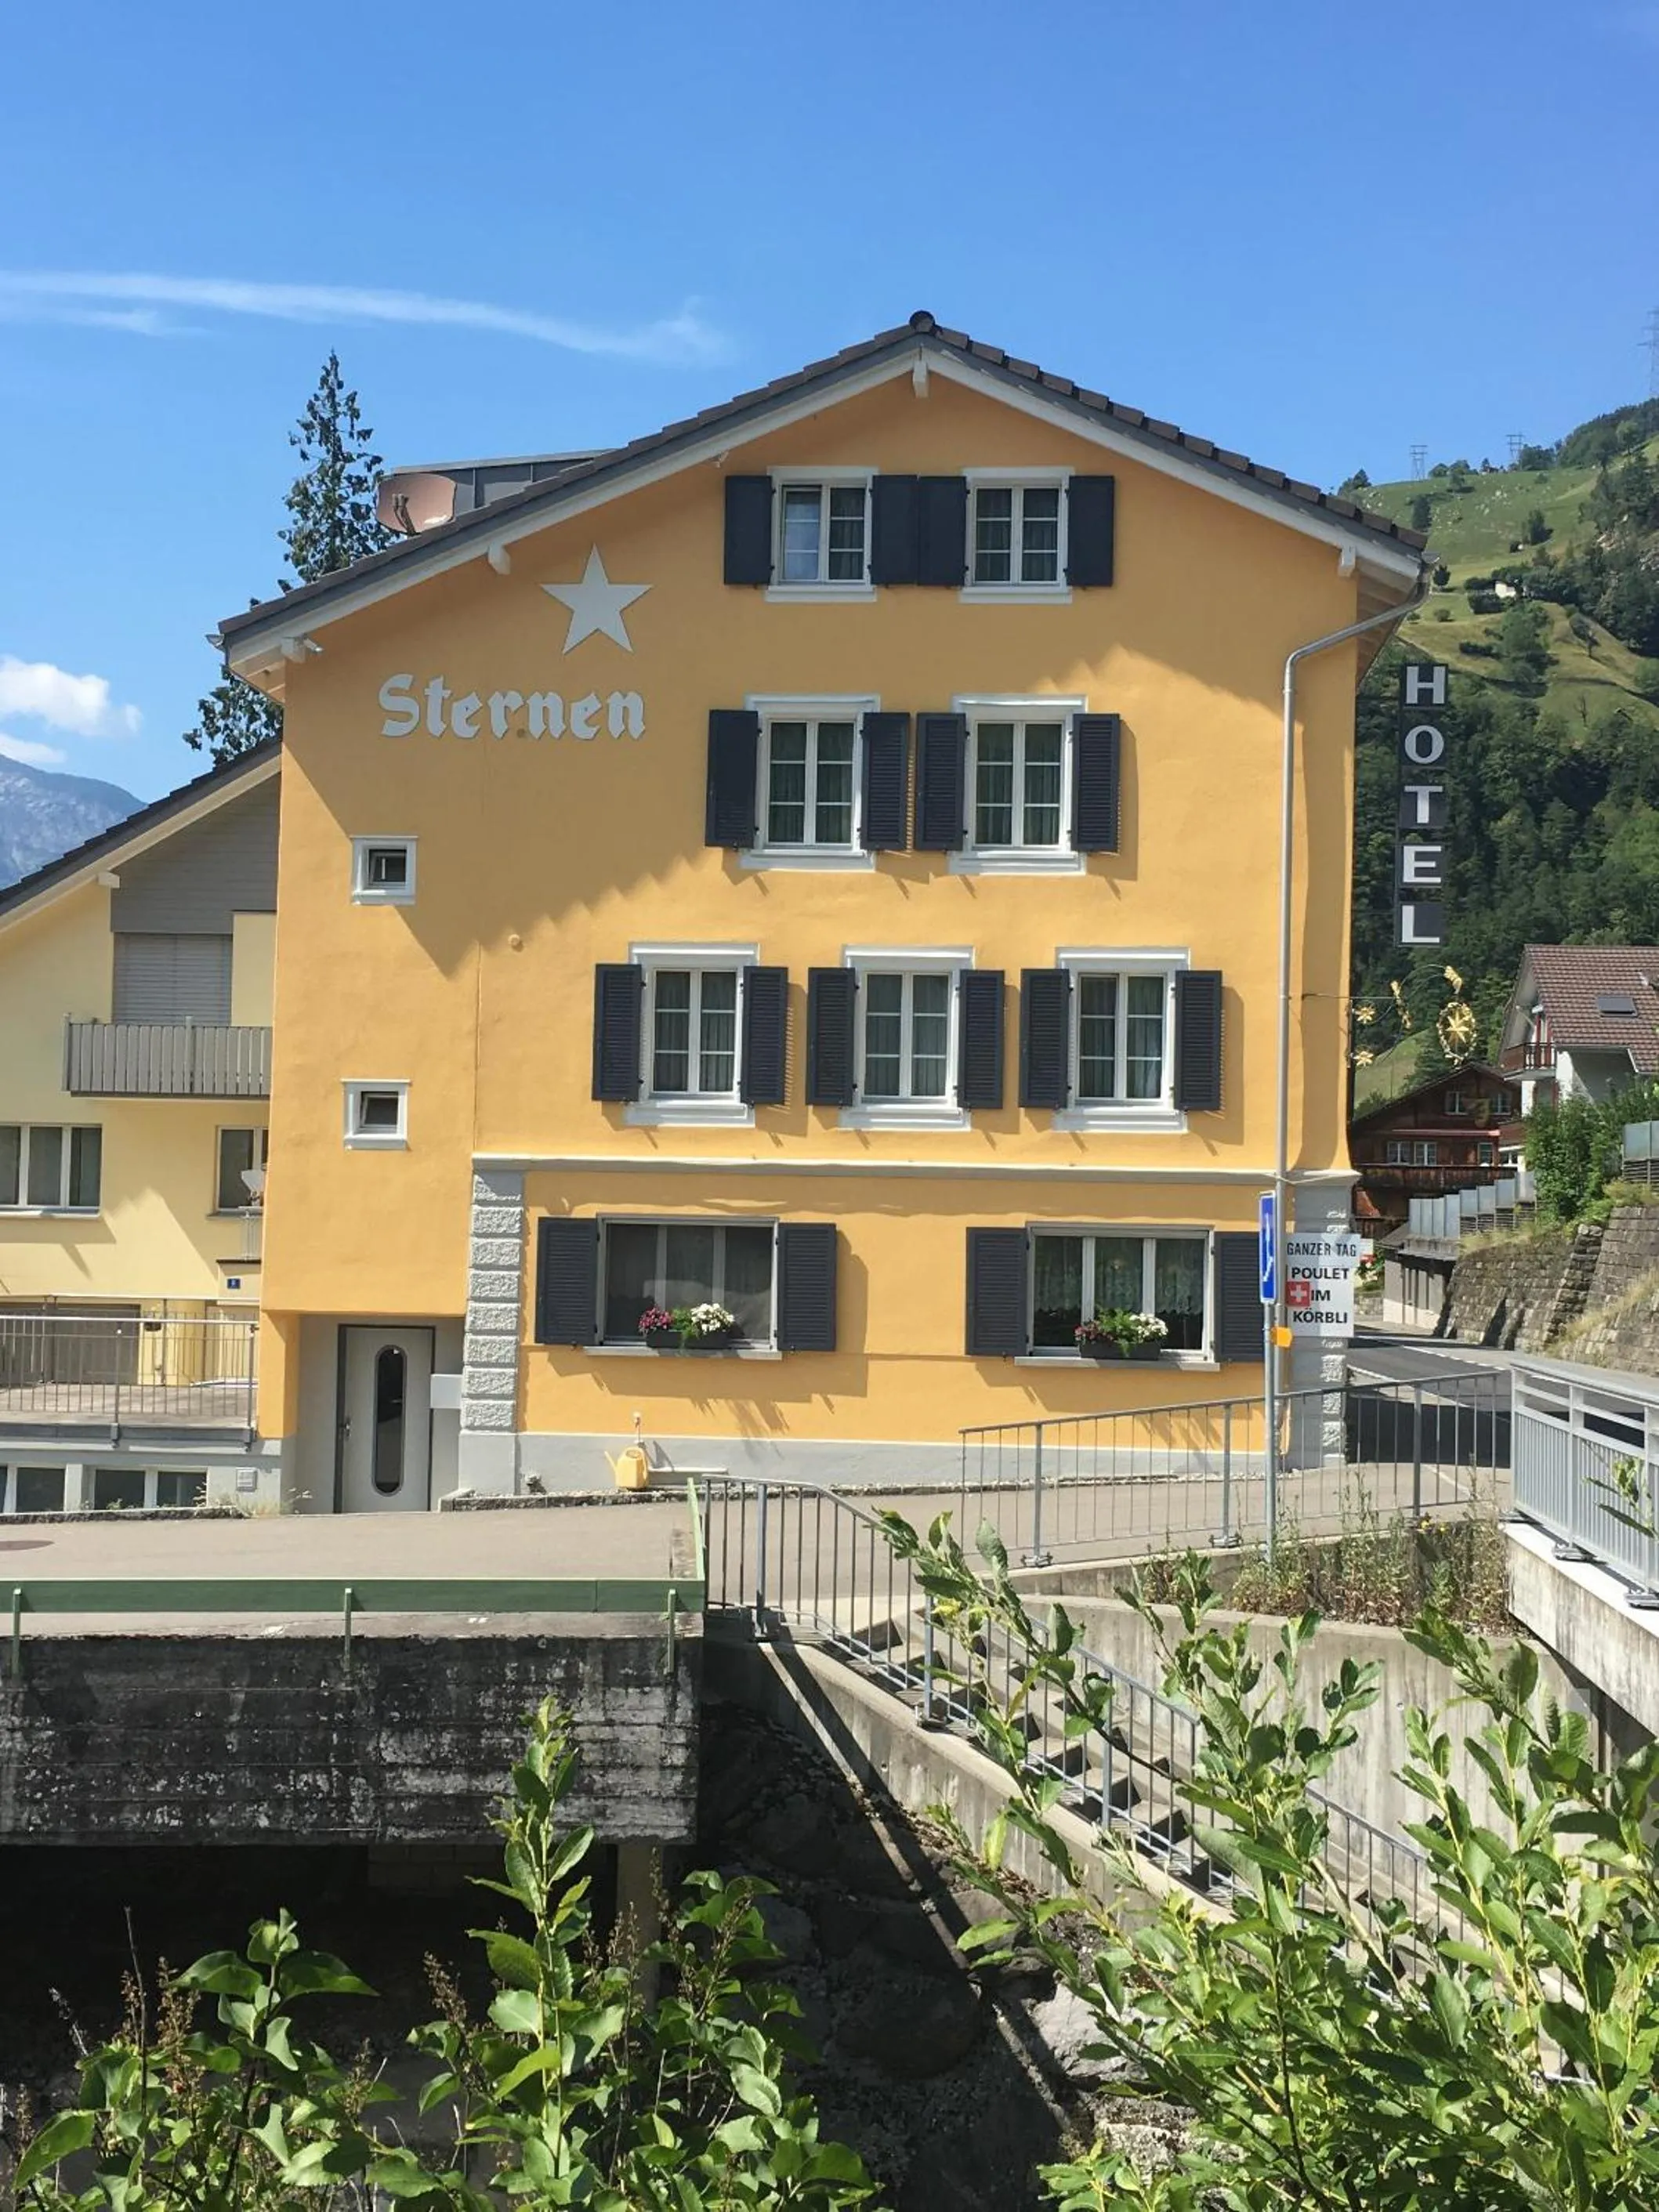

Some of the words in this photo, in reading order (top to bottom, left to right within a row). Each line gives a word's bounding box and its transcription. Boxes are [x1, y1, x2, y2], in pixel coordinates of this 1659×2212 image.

[379, 673, 646, 740] Sternen
[1401, 665, 1446, 943] HOTEL
[1286, 1242, 1331, 1257] GANZER
[1335, 1243, 1357, 1258] TAG
[1291, 1267, 1349, 1280] POULET
[1310, 1290, 1331, 1301] IM
[1292, 1307, 1348, 1323] KÖRBLI
